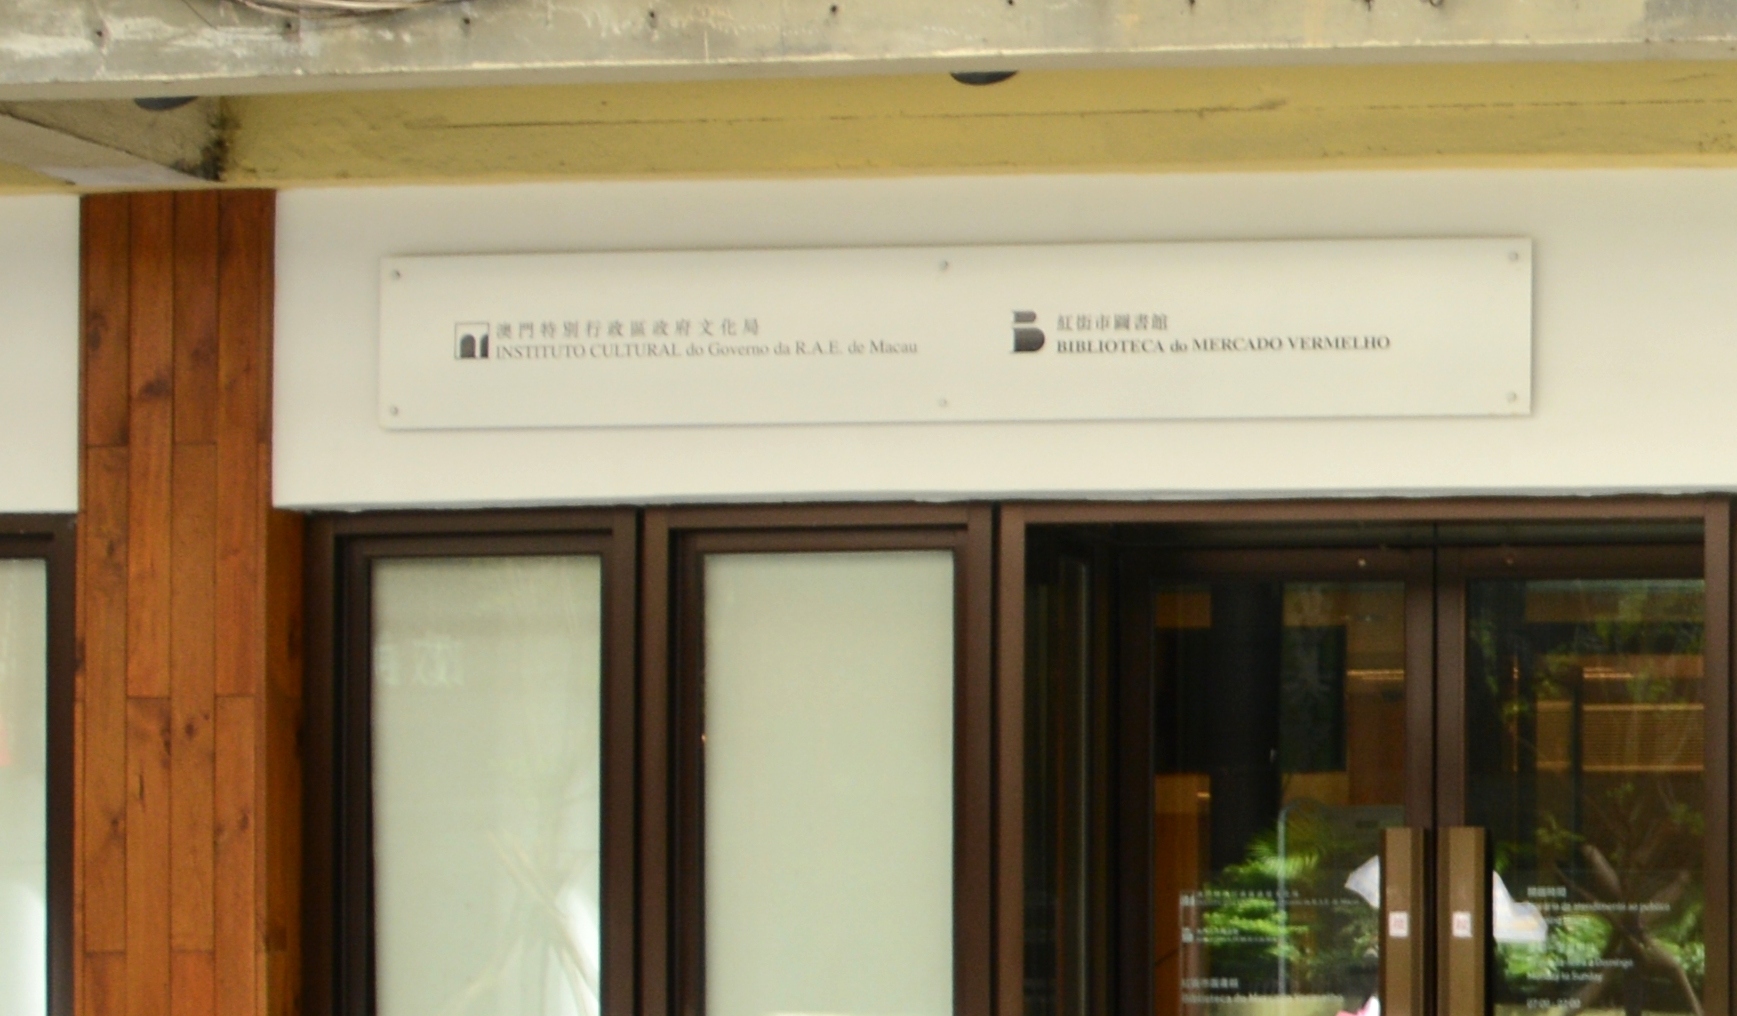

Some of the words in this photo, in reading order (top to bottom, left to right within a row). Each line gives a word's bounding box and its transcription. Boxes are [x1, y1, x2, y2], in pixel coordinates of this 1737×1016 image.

[496, 317, 760, 339] 澳門特別行政區政府文化局
[496, 344, 585, 360] INSTITUTO
[590, 342, 681, 358] CULTURAL
[686, 342, 703, 356] do
[708, 341, 769, 356] Governo
[774, 341, 790, 355] da
[796, 340, 844, 355] R.A.E.
[848, 340, 865, 354] de
[869, 339, 918, 354] Macau
[1057, 340, 1165, 354] BIBLIOTECA
[1170, 338, 1188, 352] do
[1192, 337, 1282, 351] MERCADO
[1288, 335, 1391, 350] VERMELHO
